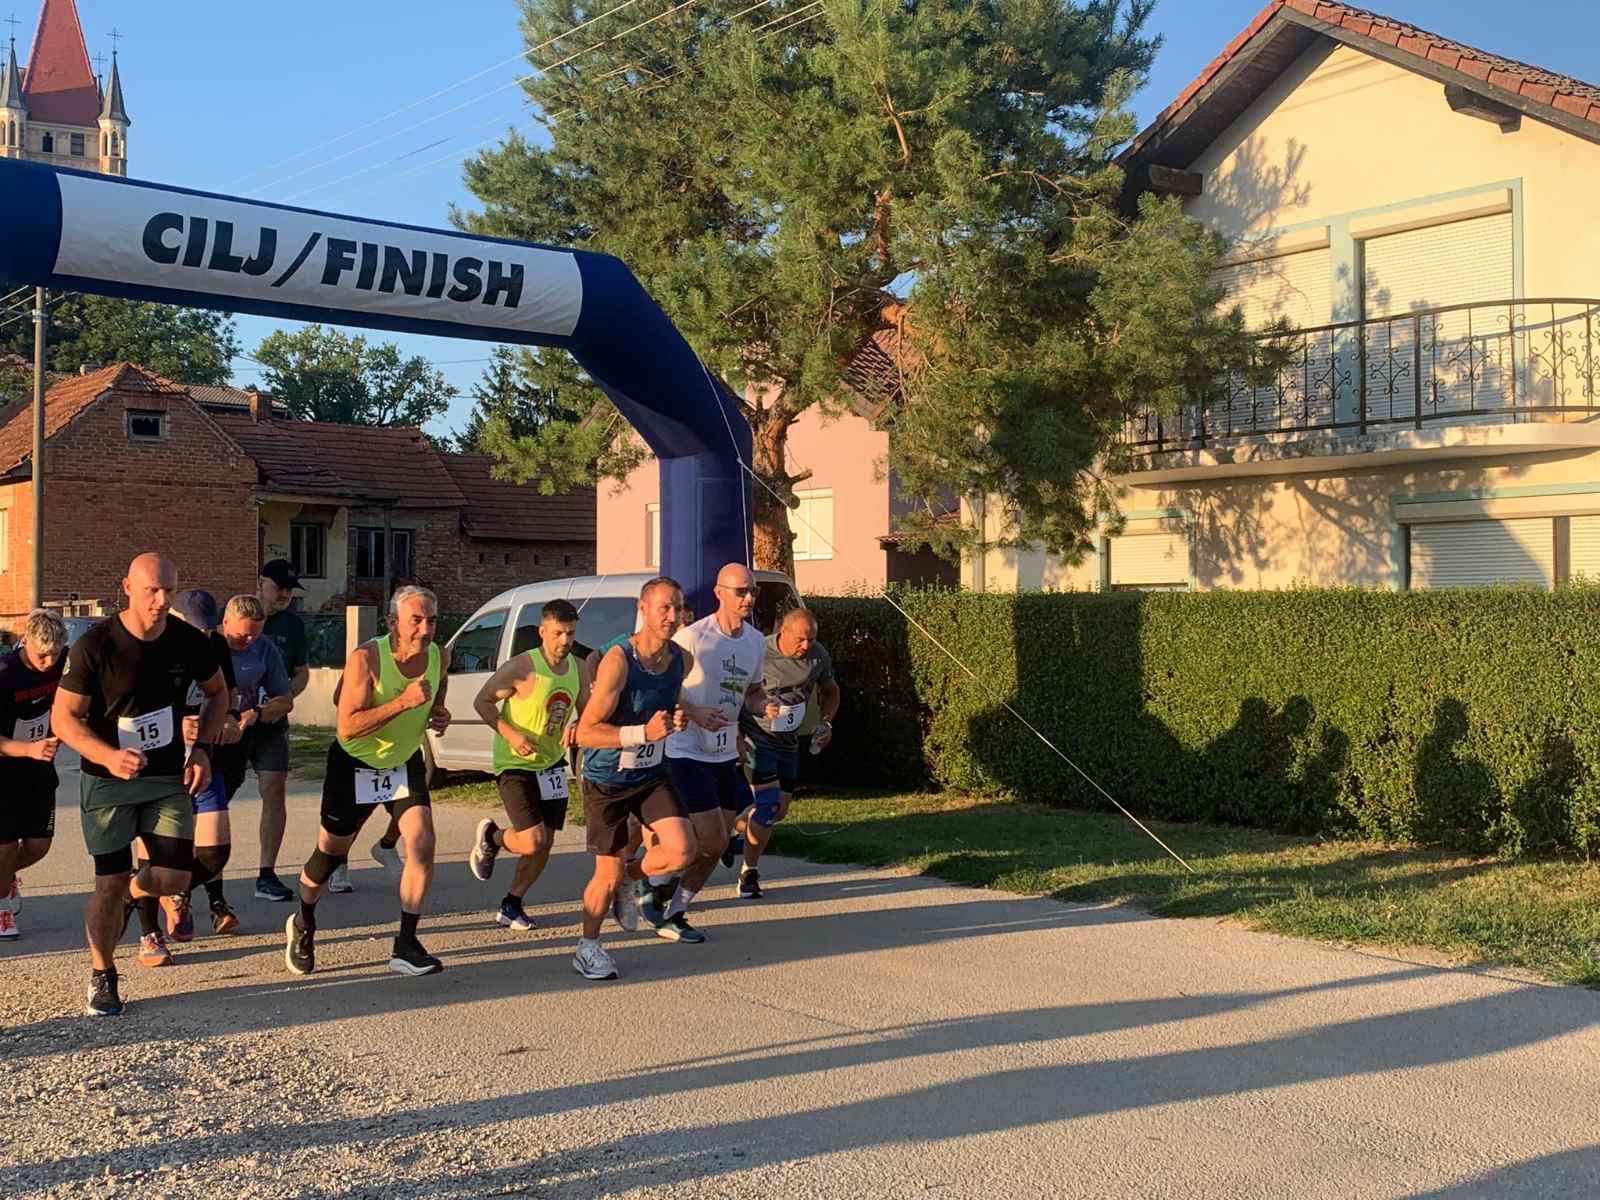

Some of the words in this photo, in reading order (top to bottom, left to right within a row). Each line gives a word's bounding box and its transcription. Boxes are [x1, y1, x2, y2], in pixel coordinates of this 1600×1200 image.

[787, 713, 794, 724] 3
[30, 724, 44, 738] 19
[136, 722, 160, 741] 15
[716, 732, 727, 746] 11
[636, 744, 655, 758] 20
[371, 776, 392, 792] 14
[548, 775, 562, 791] 12
